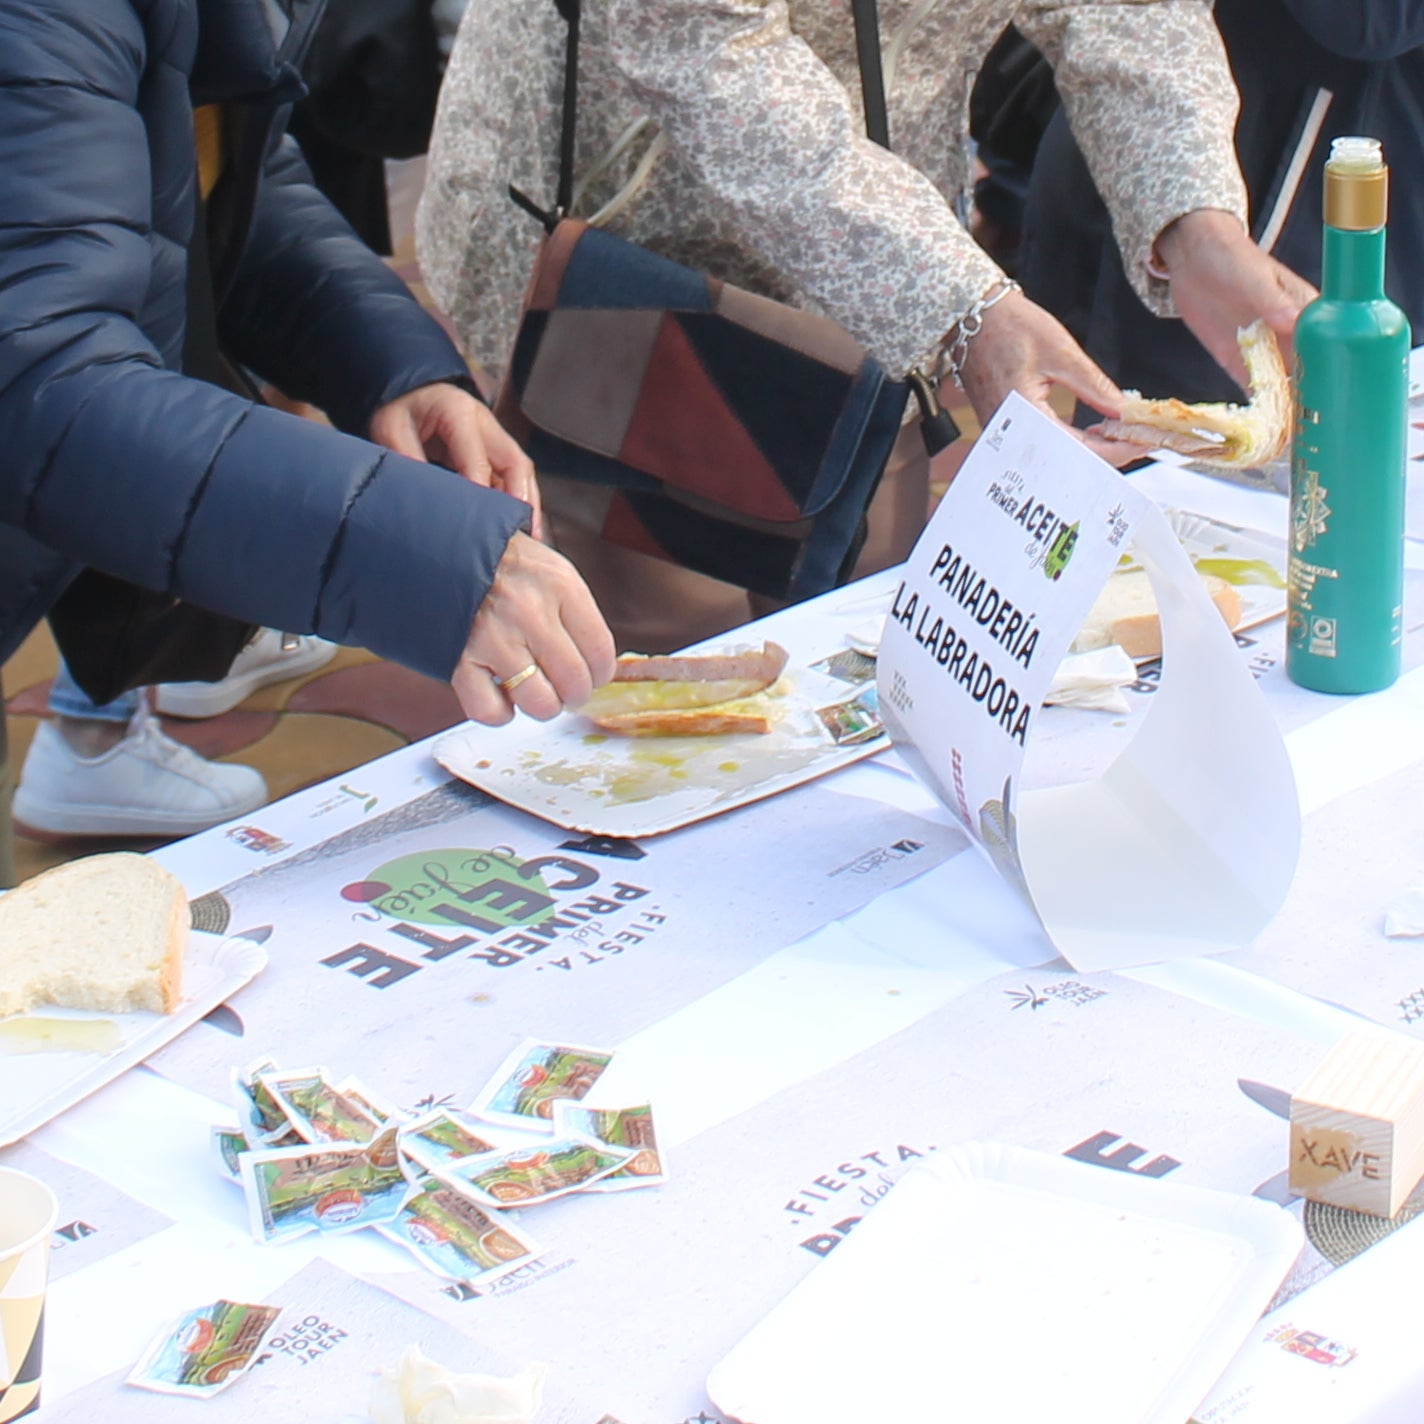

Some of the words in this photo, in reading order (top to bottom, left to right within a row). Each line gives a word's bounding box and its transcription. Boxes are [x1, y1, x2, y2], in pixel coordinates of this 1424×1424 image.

[986, 481, 1019, 518] PRIMER
[1013, 495, 1079, 563] ACEITE
[929, 543, 1040, 670] PANADERÍA
[890, 581, 919, 632] LA
[915, 605, 1031, 748] LABRADORA
[459, 844, 517, 878] de
[466, 882, 652, 970] PRIMER
[562, 920, 606, 947] del
[1298, 1136, 1380, 1181] XAVE
[268, 1314, 320, 1349] OLEO
[280, 1322, 336, 1356] TOUR
